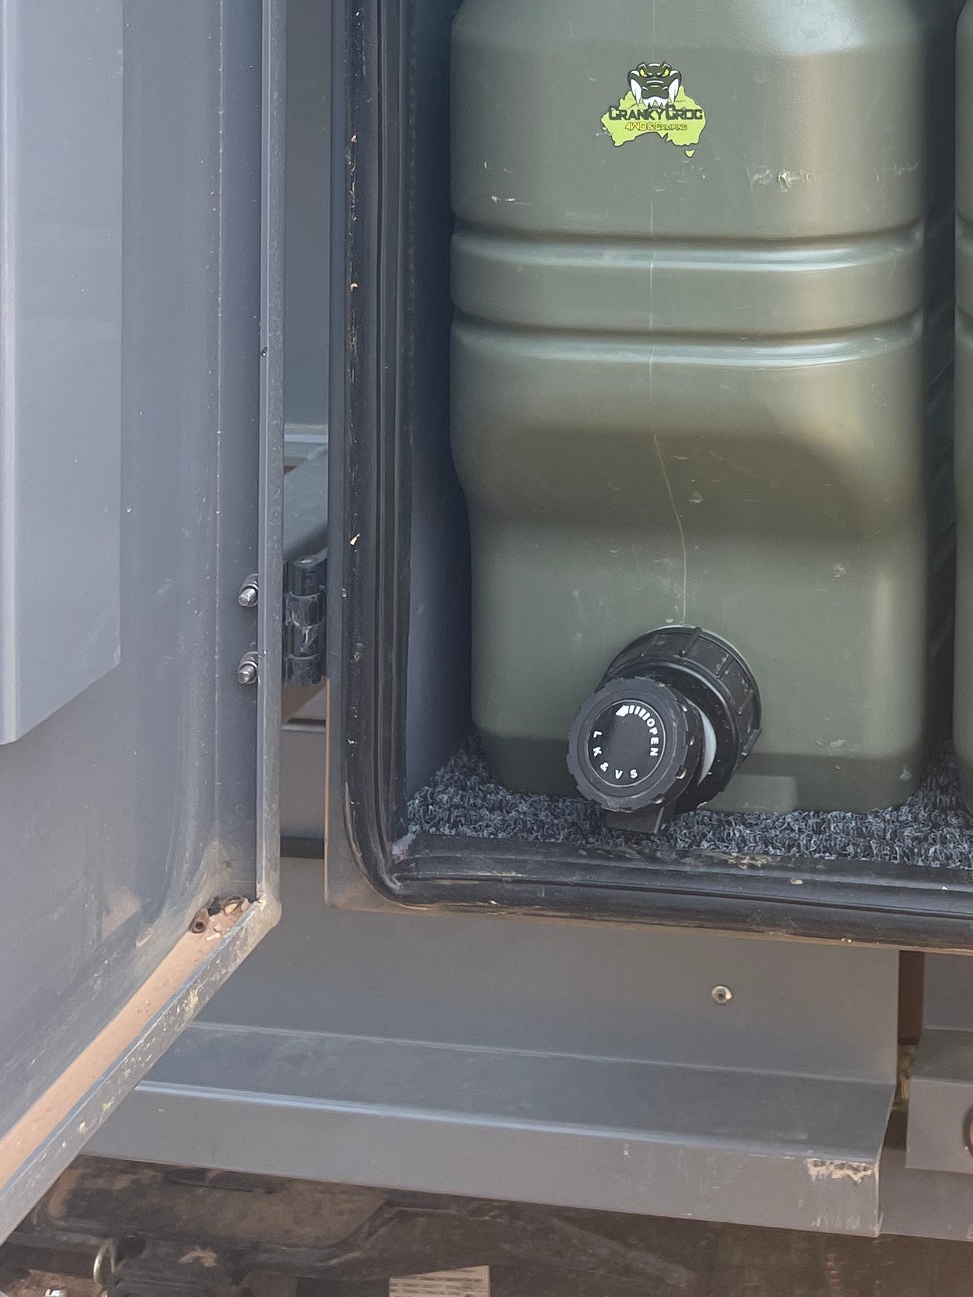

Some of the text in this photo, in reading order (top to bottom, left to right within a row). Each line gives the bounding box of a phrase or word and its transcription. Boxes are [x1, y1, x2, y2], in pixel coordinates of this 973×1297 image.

[608, 104, 703, 121] CRANKY CROC
[625, 122, 647, 131] 4WD
[646, 717, 659, 757] OPEN
